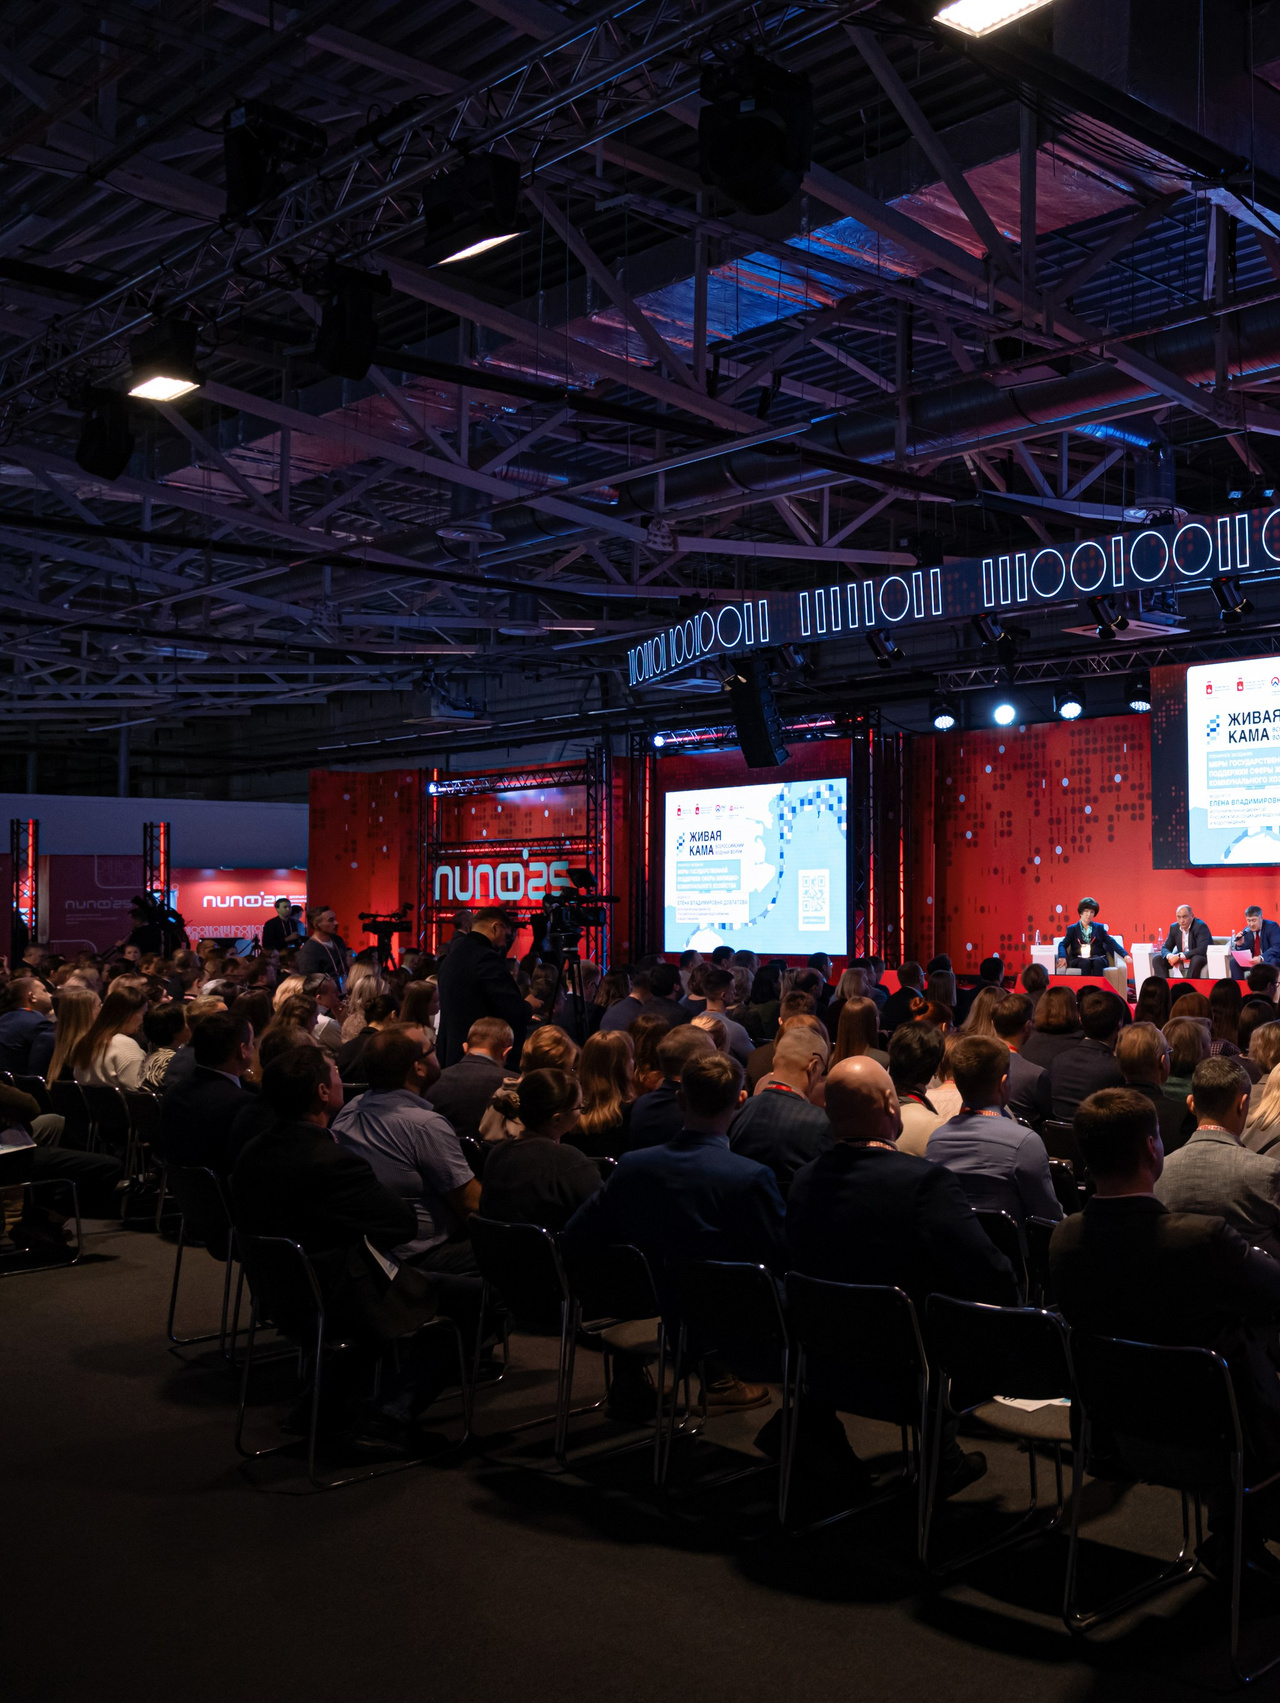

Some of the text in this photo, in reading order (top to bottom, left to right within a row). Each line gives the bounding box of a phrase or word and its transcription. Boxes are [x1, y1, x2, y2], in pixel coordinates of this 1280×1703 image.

[1228, 727, 1270, 743] КАМА
[689, 830, 722, 842] ЖИВАЯ
[689, 844, 714, 856] КАМА
